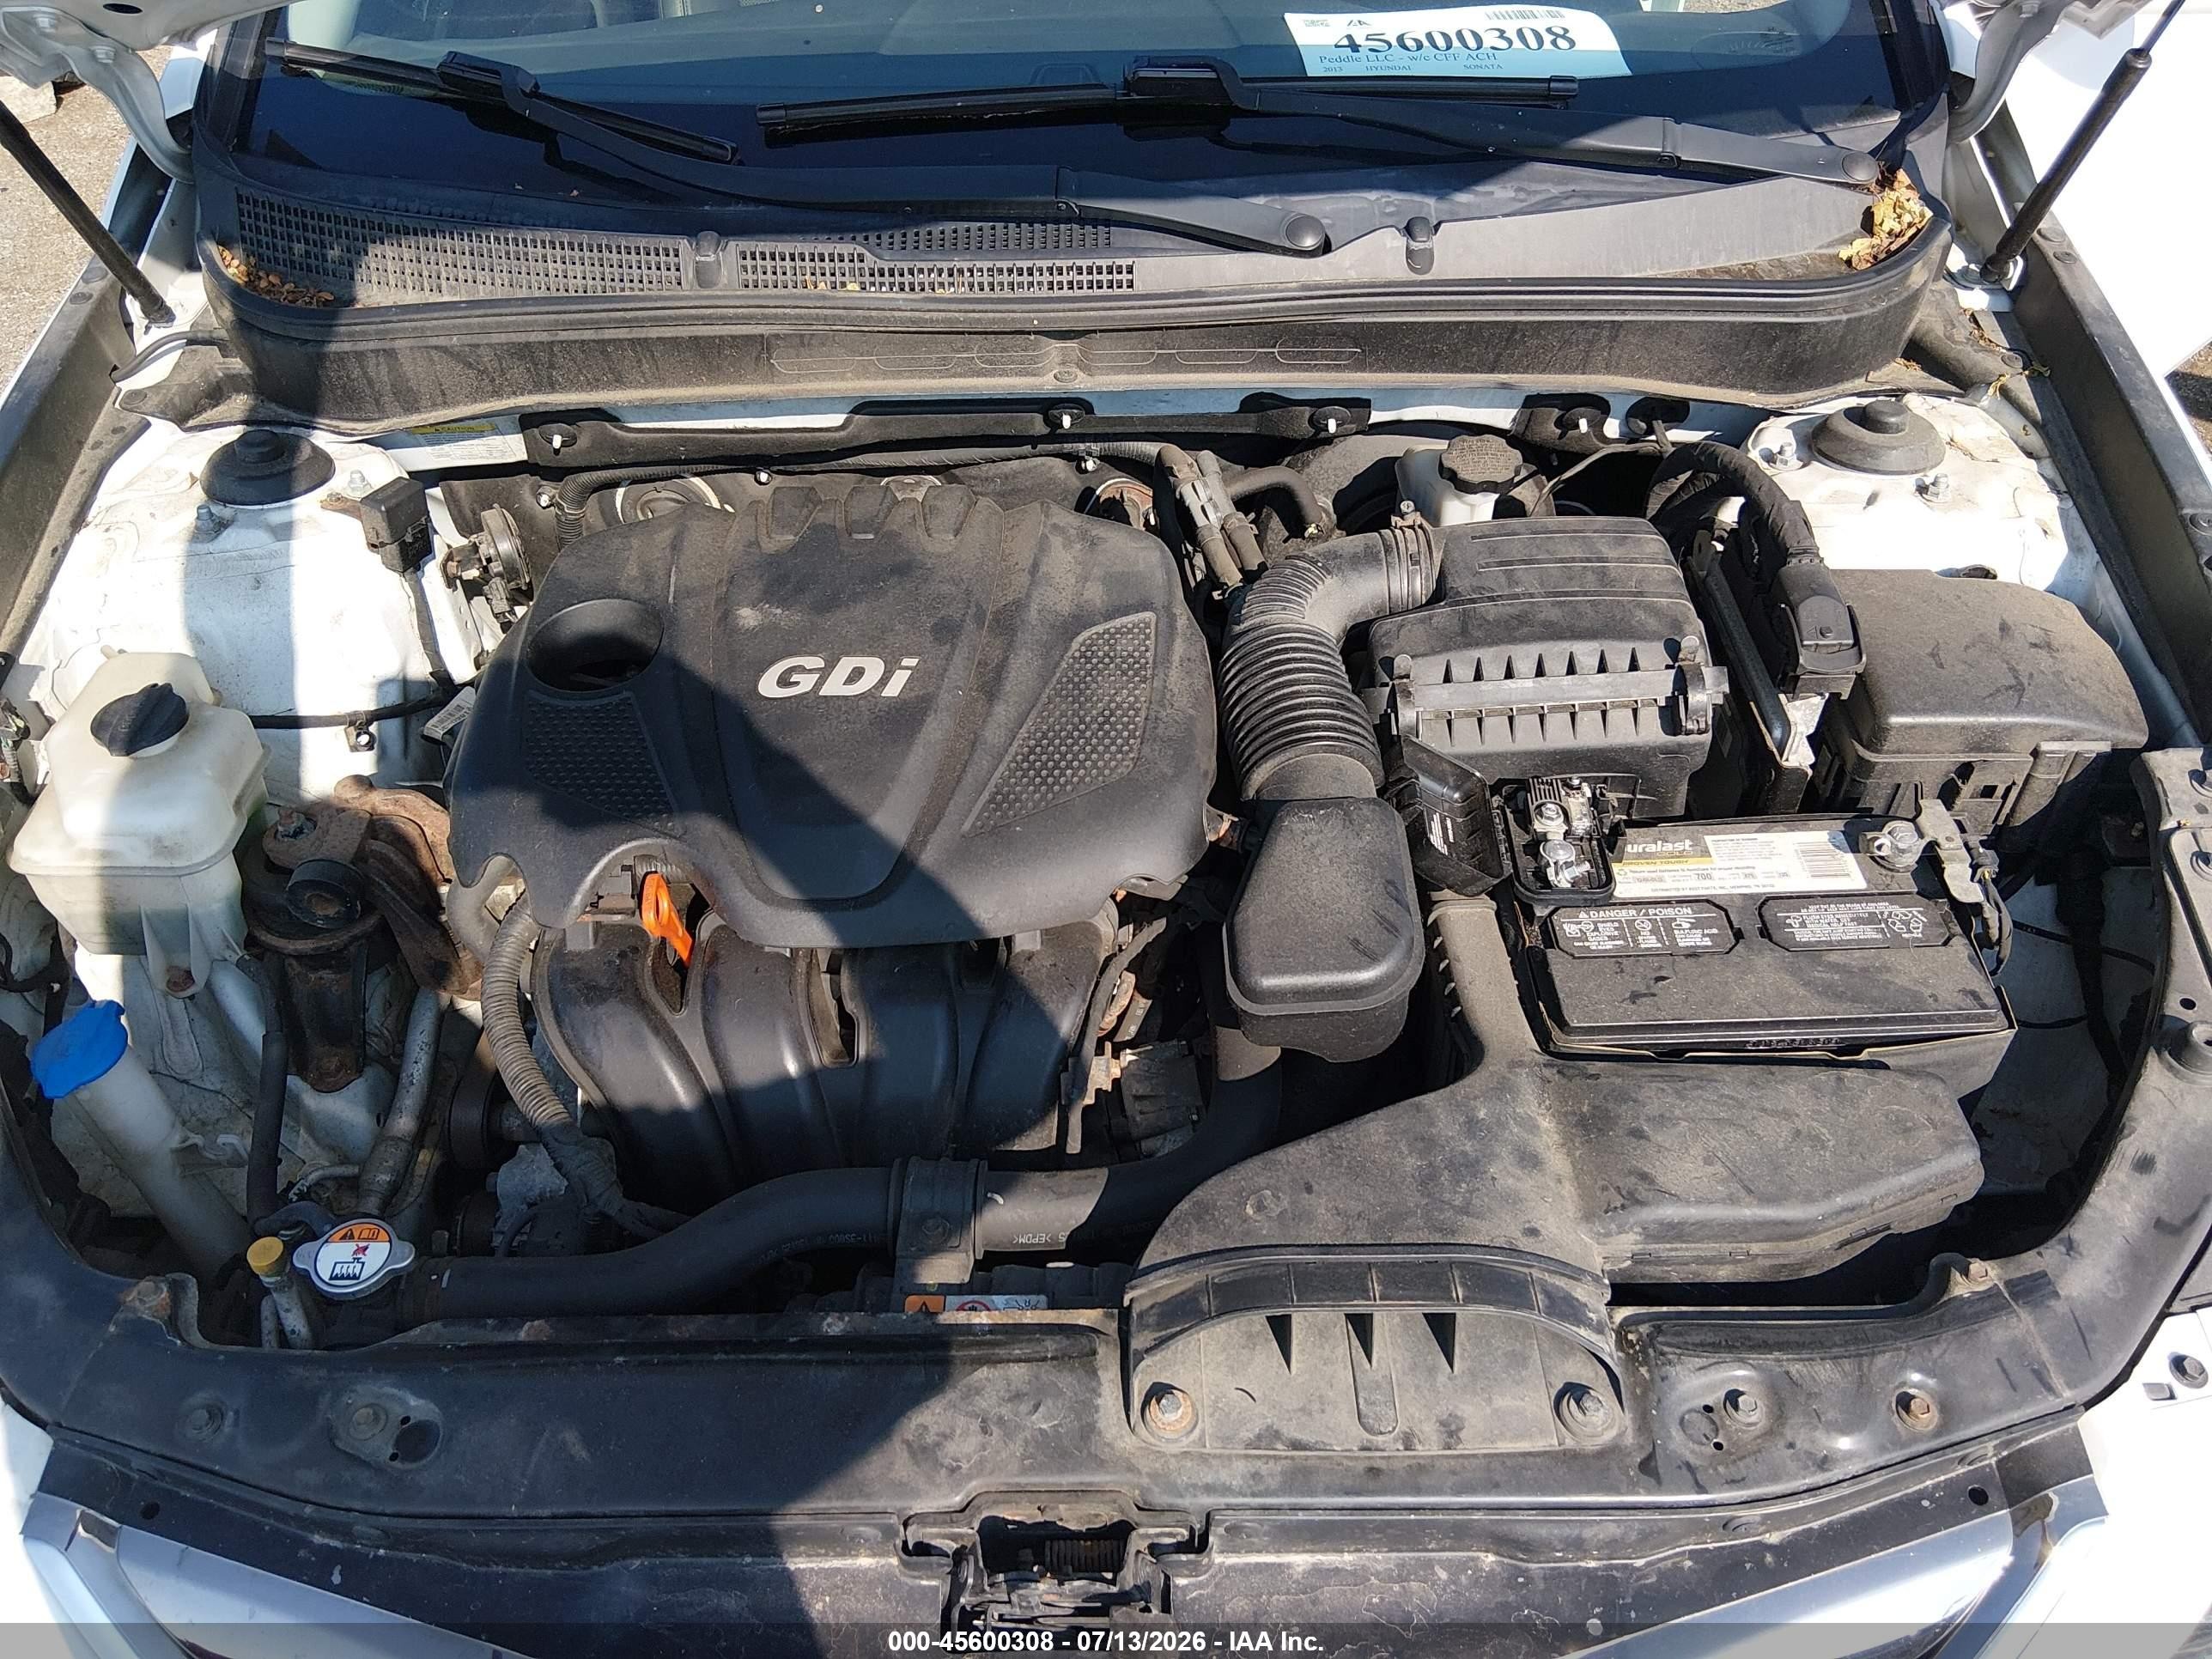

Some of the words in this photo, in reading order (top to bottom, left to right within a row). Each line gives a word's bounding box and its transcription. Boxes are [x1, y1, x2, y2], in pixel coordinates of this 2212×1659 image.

[1334, 26, 1577, 53] 45600308
[1366, 53, 1395, 62] LLC
[1466, 52, 1498, 61] ACH
[757, 655, 921, 698] GDi
[1625, 839, 1694, 853] uralast
[1589, 909, 1638, 918] DANGER
[1649, 907, 1692, 915] POISON
